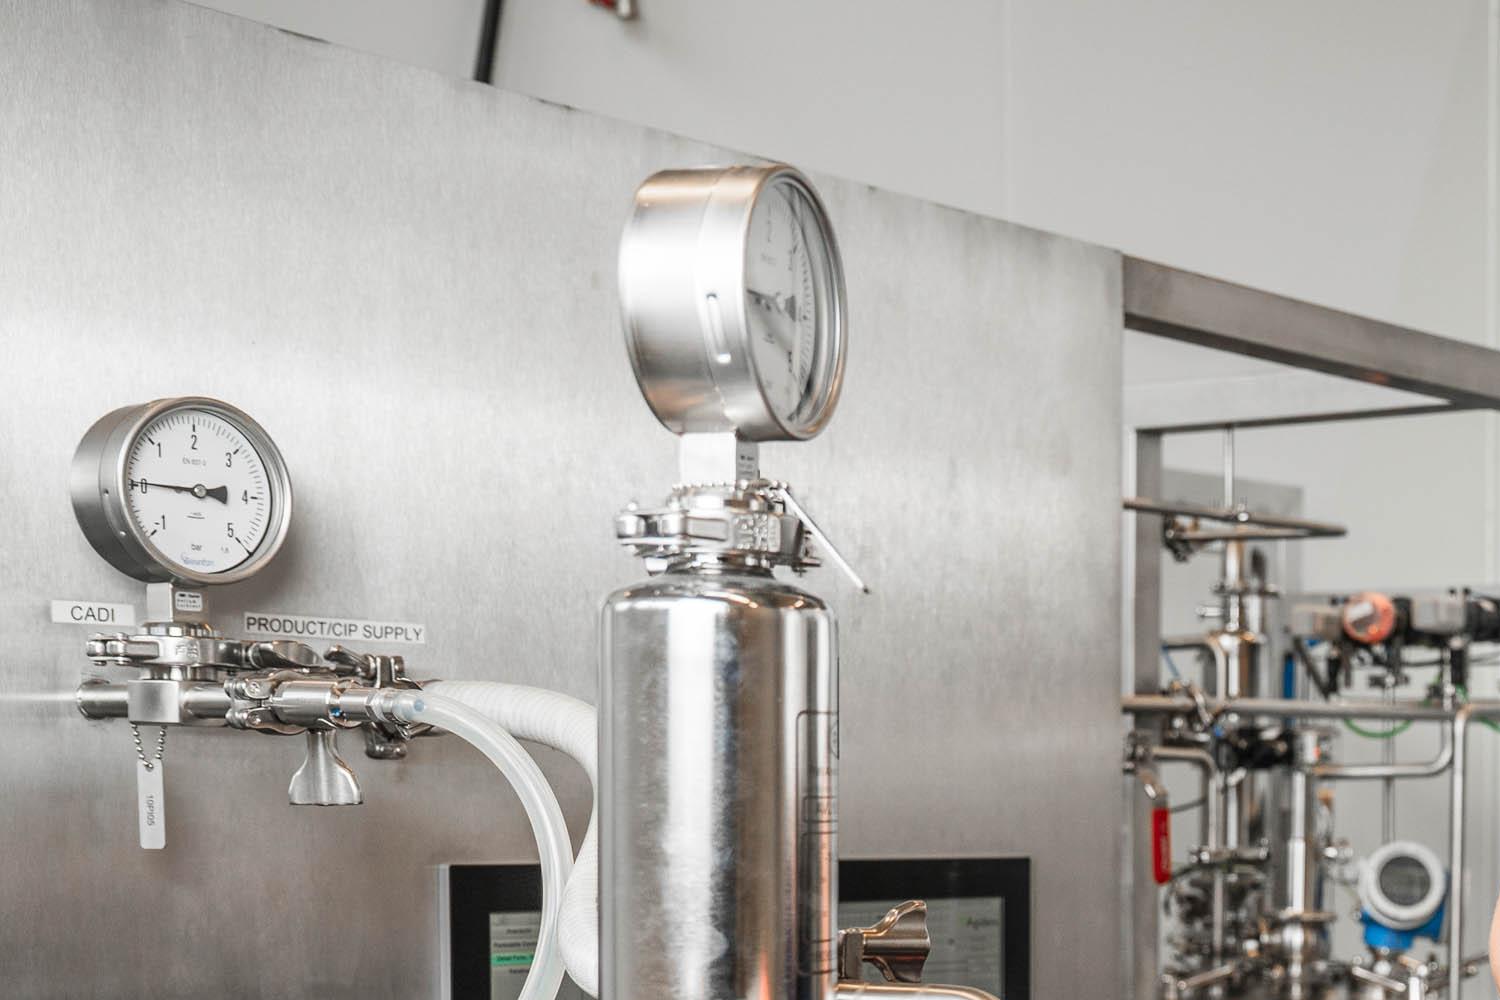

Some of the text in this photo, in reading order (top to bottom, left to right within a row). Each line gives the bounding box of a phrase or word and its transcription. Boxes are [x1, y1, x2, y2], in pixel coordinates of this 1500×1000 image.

[156, 442, 162, 458] 1
[191, 434, 198, 450] 2
[225, 452, 232, 468] 3
[140, 478, 147, 494] 0
[241, 490, 249, 505] 4
[226, 522, 234, 538] 5
[70, 605, 115, 622] CADI
[246, 616, 423, 641] PRODUCT/CIP SUPPLY
